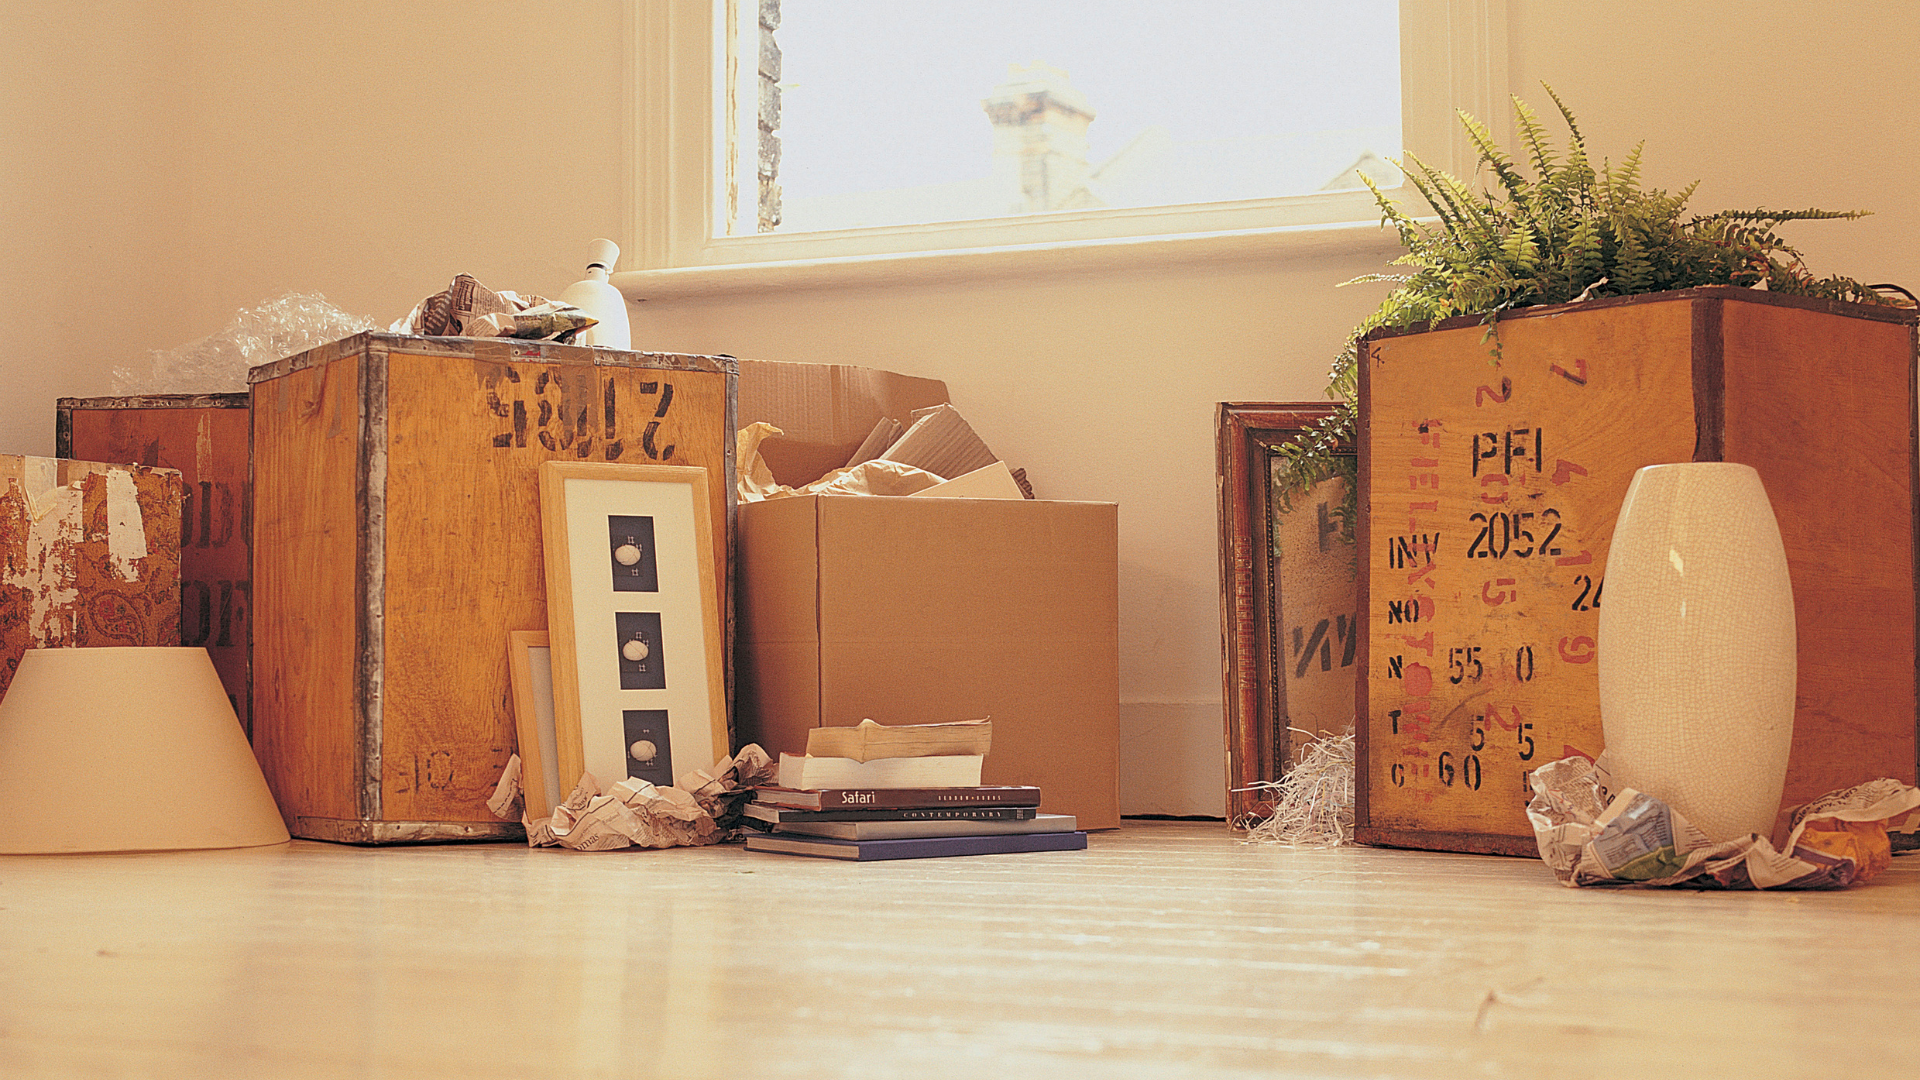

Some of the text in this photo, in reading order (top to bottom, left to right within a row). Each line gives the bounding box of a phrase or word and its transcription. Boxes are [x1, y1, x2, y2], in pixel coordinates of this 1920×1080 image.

[1467, 508, 1562, 560] 2052
[1389, 532, 1440, 569] INV
[1388, 710, 1401, 734] T
[841, 791, 876, 804] Safari
